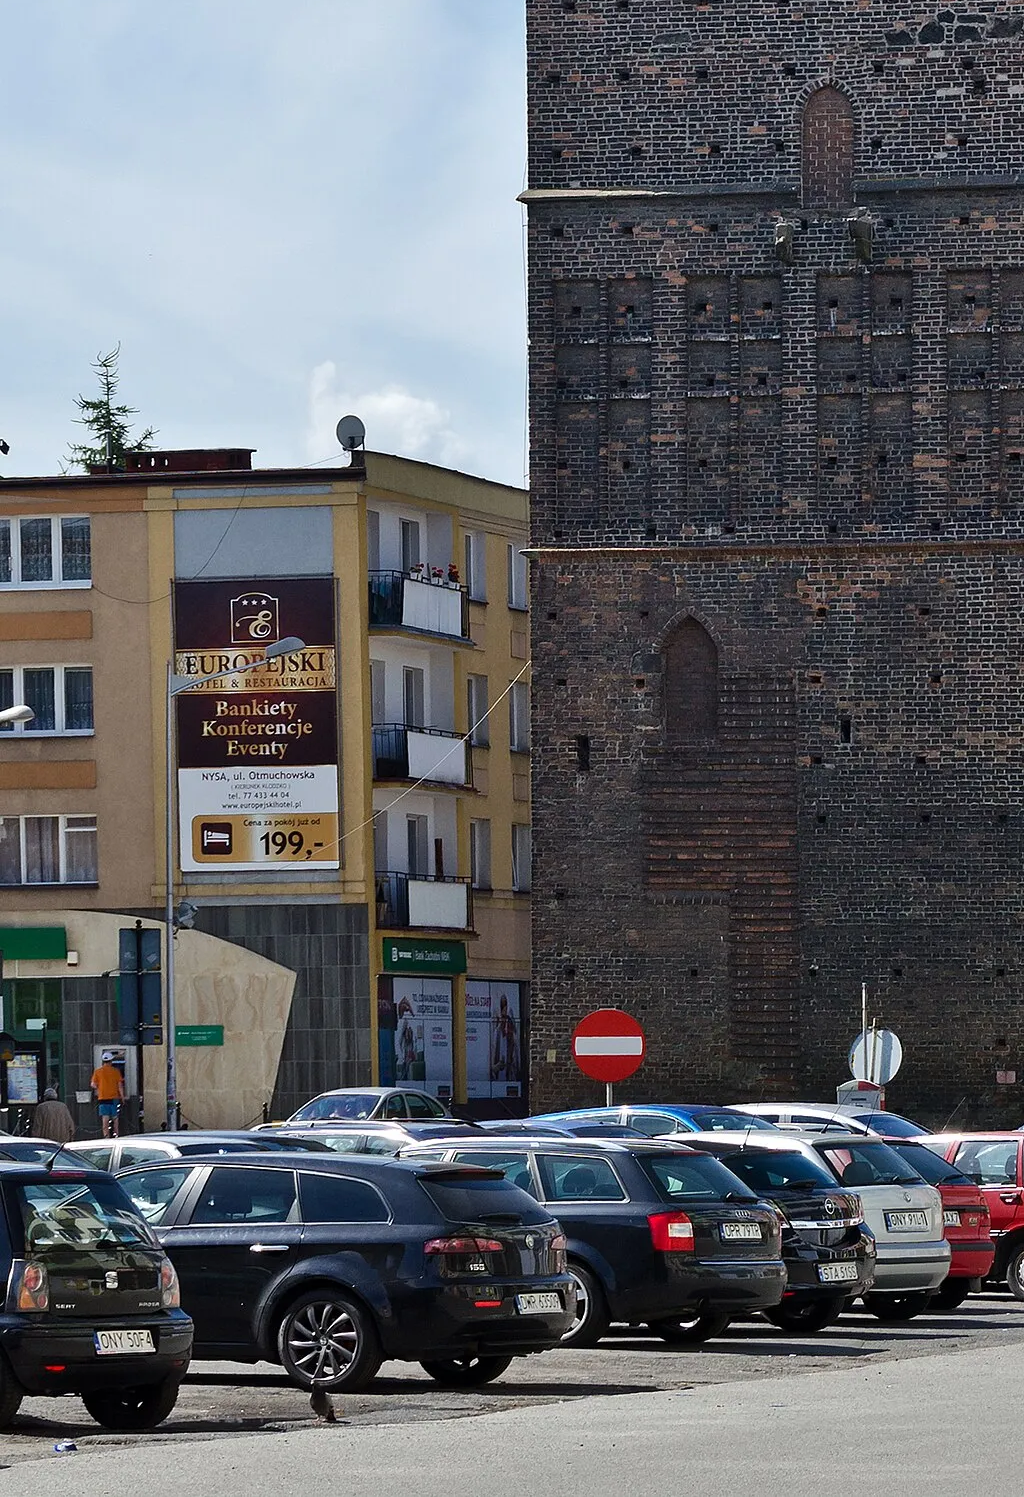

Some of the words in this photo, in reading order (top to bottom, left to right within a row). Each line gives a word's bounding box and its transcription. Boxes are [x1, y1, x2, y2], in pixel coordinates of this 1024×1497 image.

[186, 653, 325, 676] EUROPEJSKI
[189, 677, 226, 689] OTEL
[231, 679, 240, 689] &
[245, 676, 327, 688] RESTAURACJA
[216, 699, 298, 719] Bankiety
[202, 719, 313, 739] Konferencje
[227, 740, 289, 759] Eventy
[202, 772, 230, 782] NYSA,
[234, 772, 245, 781] ul.
[249, 770, 315, 781] Otmuchowska
[228, 792, 241, 800] tel.
[254, 791, 268, 799] 433
[280, 791, 290, 799] 04
[243, 819, 262, 827] Cena
[274, 818, 295, 828] pokój
[297, 818, 309, 827] już
[260, 831, 323, 859] 199,-
[823, 1267, 839, 1281] STA
[100, 1332, 124, 1349] ONY
[127, 1331, 153, 1349] 50F4
